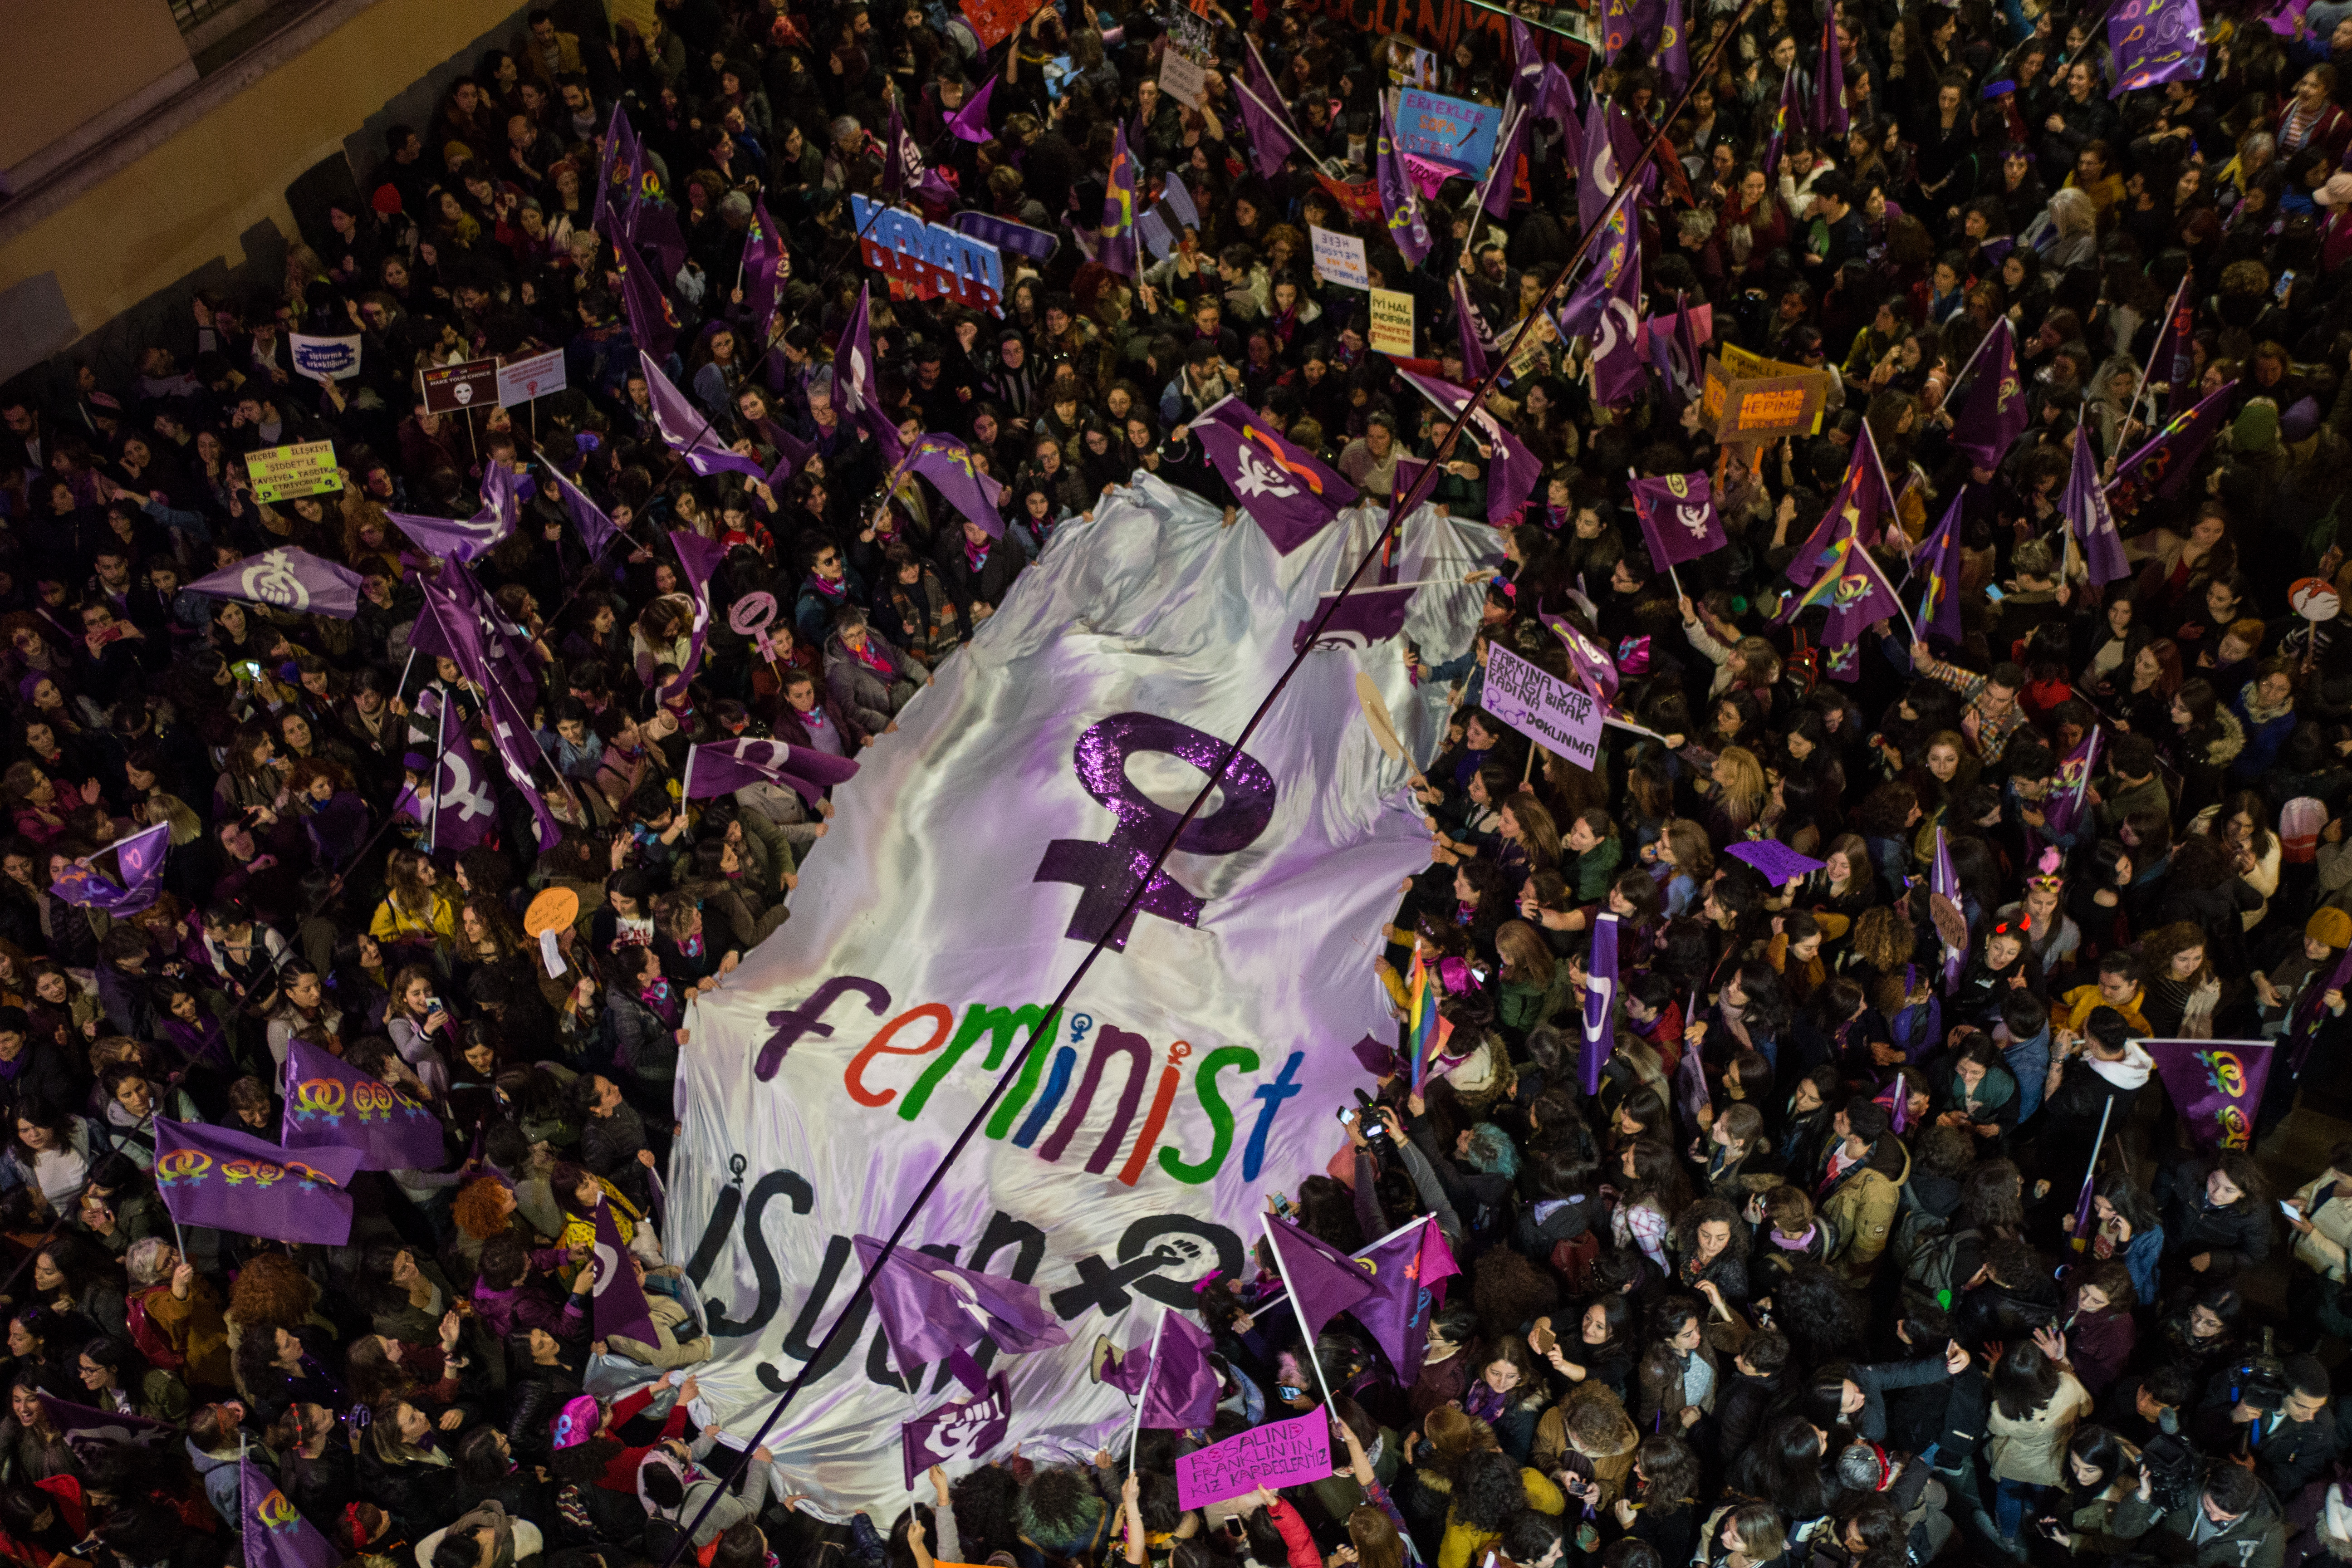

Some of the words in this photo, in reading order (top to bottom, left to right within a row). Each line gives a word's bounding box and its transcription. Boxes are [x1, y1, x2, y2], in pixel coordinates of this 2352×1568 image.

[1419, 114, 1457, 136] SOPA
[1388, 300, 1410, 315] HAL
[429, 378, 448, 387] MAKE
[448, 375, 466, 383] YOUR
[467, 370, 491, 380] CHOICE
[246, 449, 277, 462] HİÇBİR
[1488, 671, 1541, 710] KADINA
[1493, 648, 1552, 691] FARKINA
[1558, 683, 1592, 714] VAR
[1545, 693, 1588, 725] BIRAK
[1526, 712, 1595, 759] DOKUNMA
[755, 975, 1305, 1186] feminist
[1191, 1422, 1304, 1470] ROSALIND
[1191, 1479, 1225, 1498] KIZ
